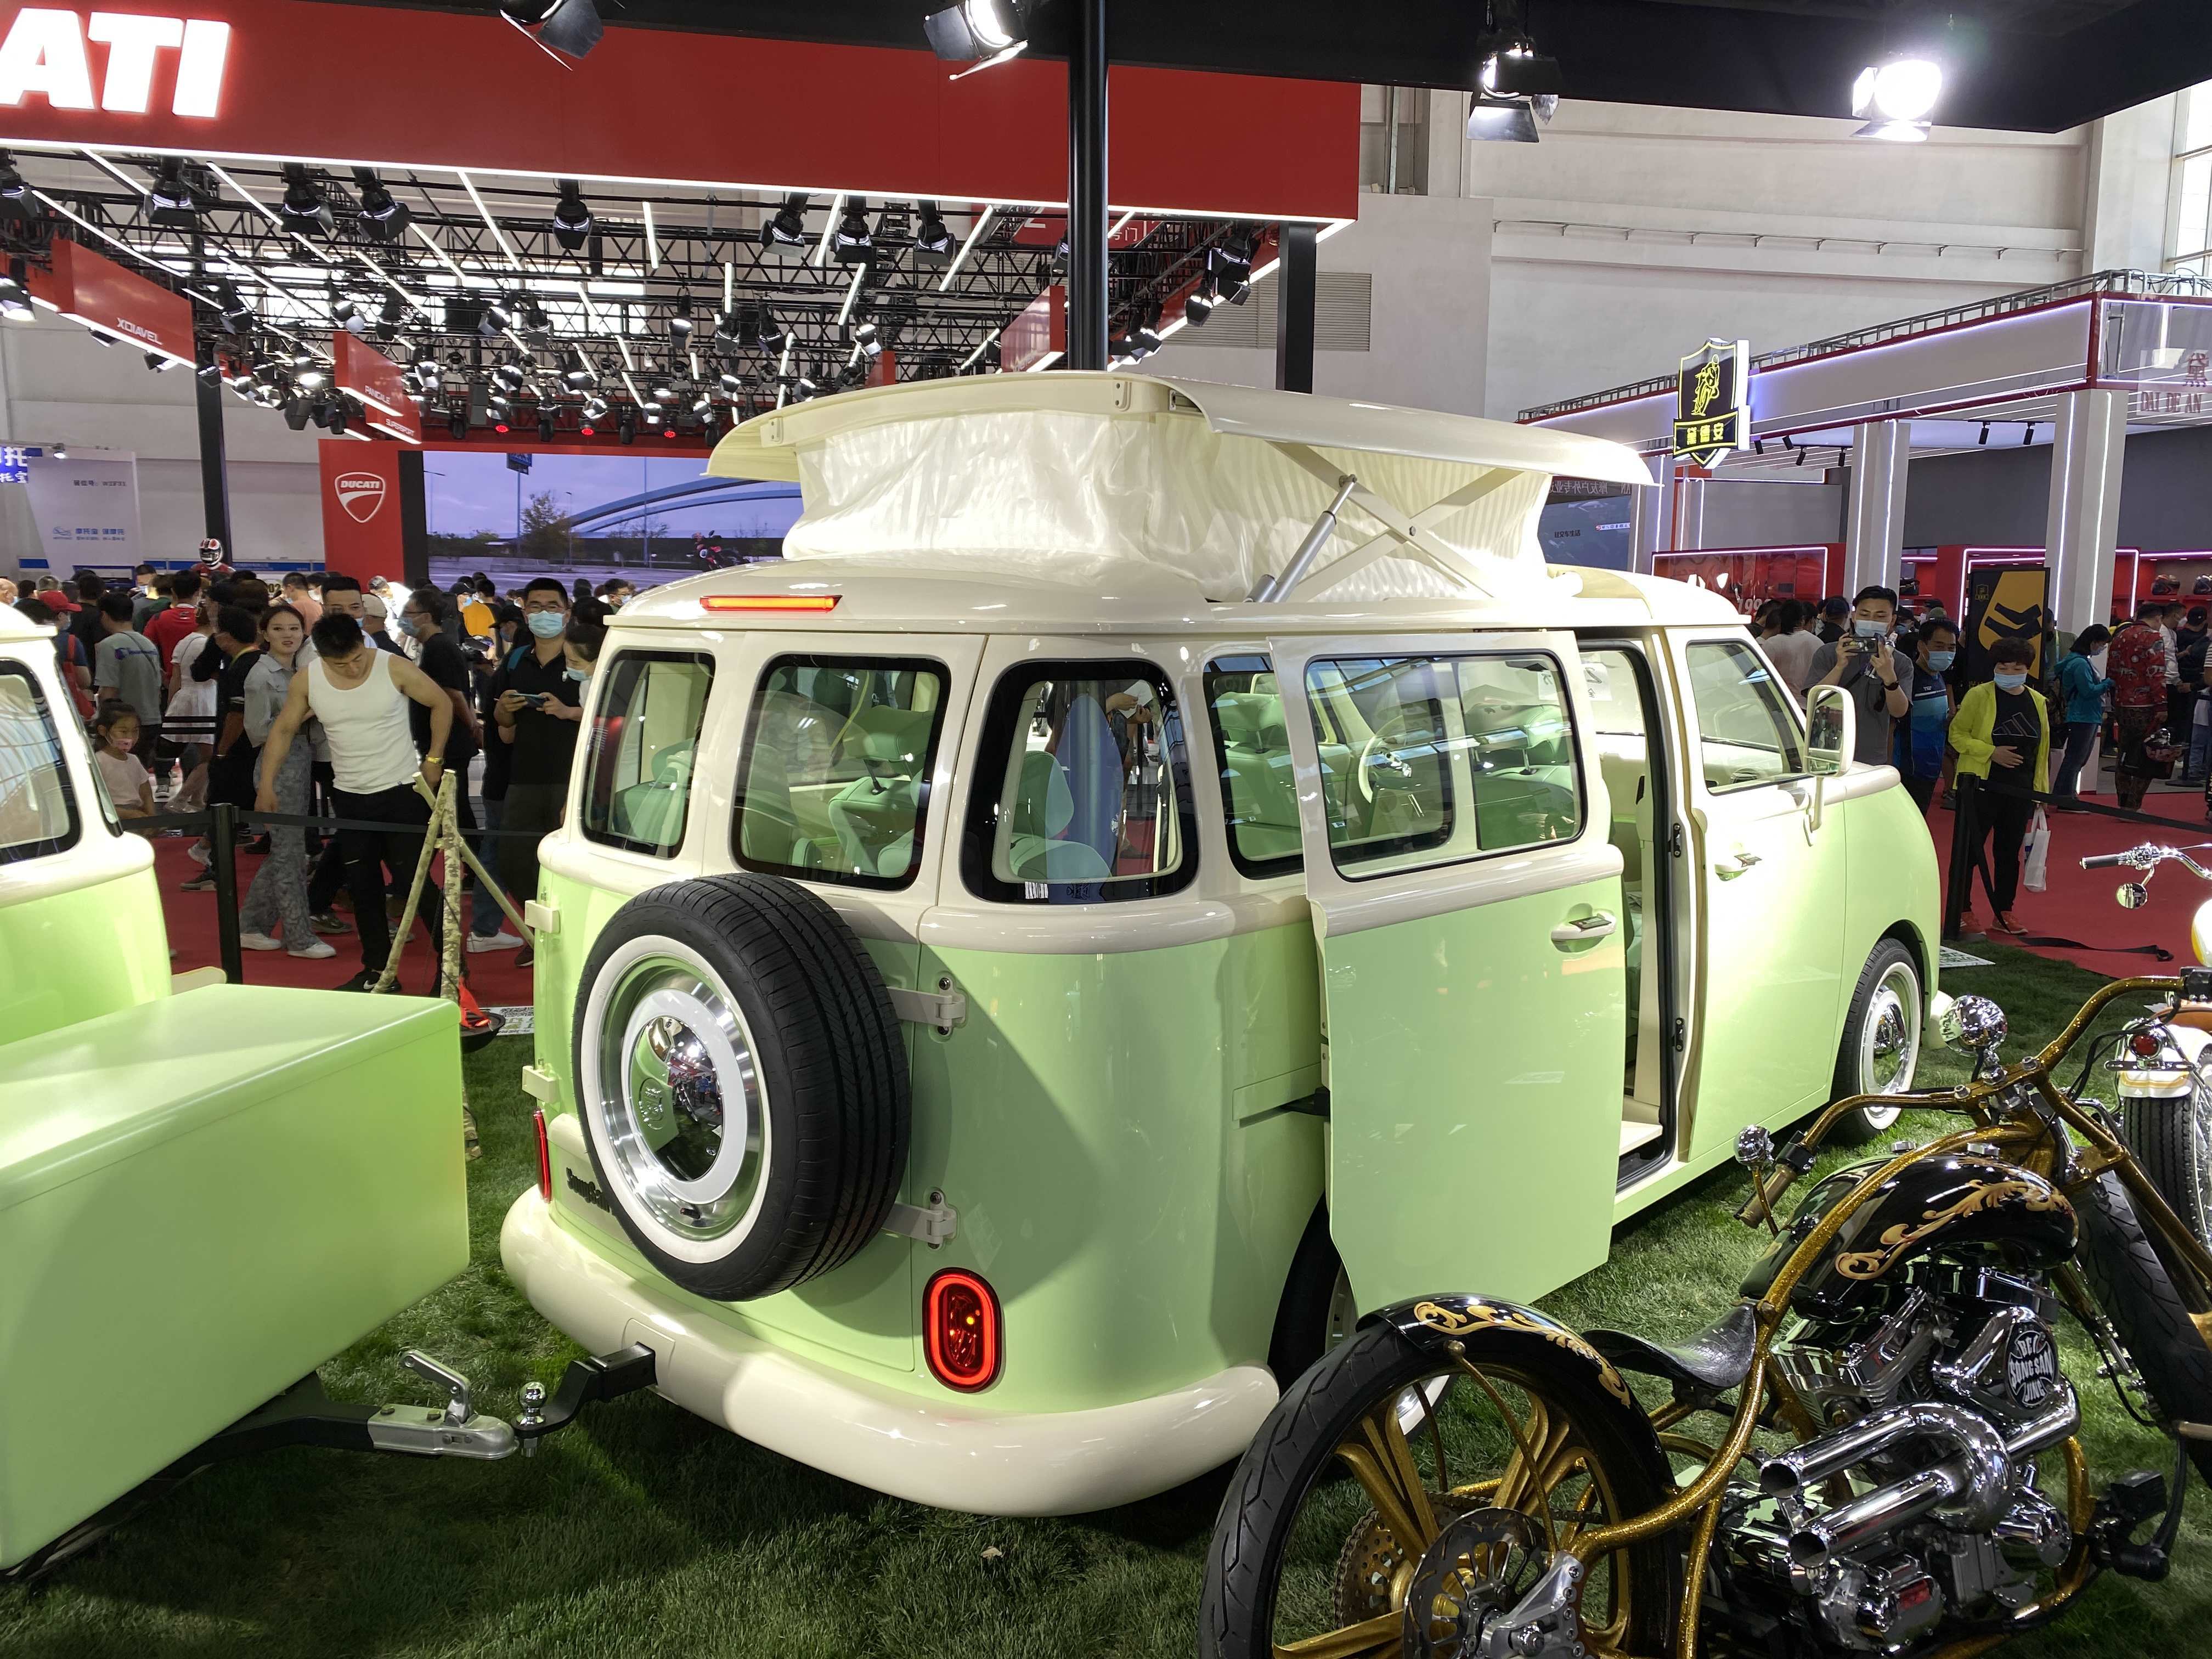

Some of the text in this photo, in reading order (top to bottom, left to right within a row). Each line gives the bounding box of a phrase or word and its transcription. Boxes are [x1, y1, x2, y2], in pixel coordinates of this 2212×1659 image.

[116, 317, 163, 346] XDIAVEL
[2141, 391, 2202, 413] DAI DE AN
[340, 480, 381, 489] DUCATI
[2017, 1334, 2039, 1357] BEI
[2024, 1379, 2046, 1402] JING
